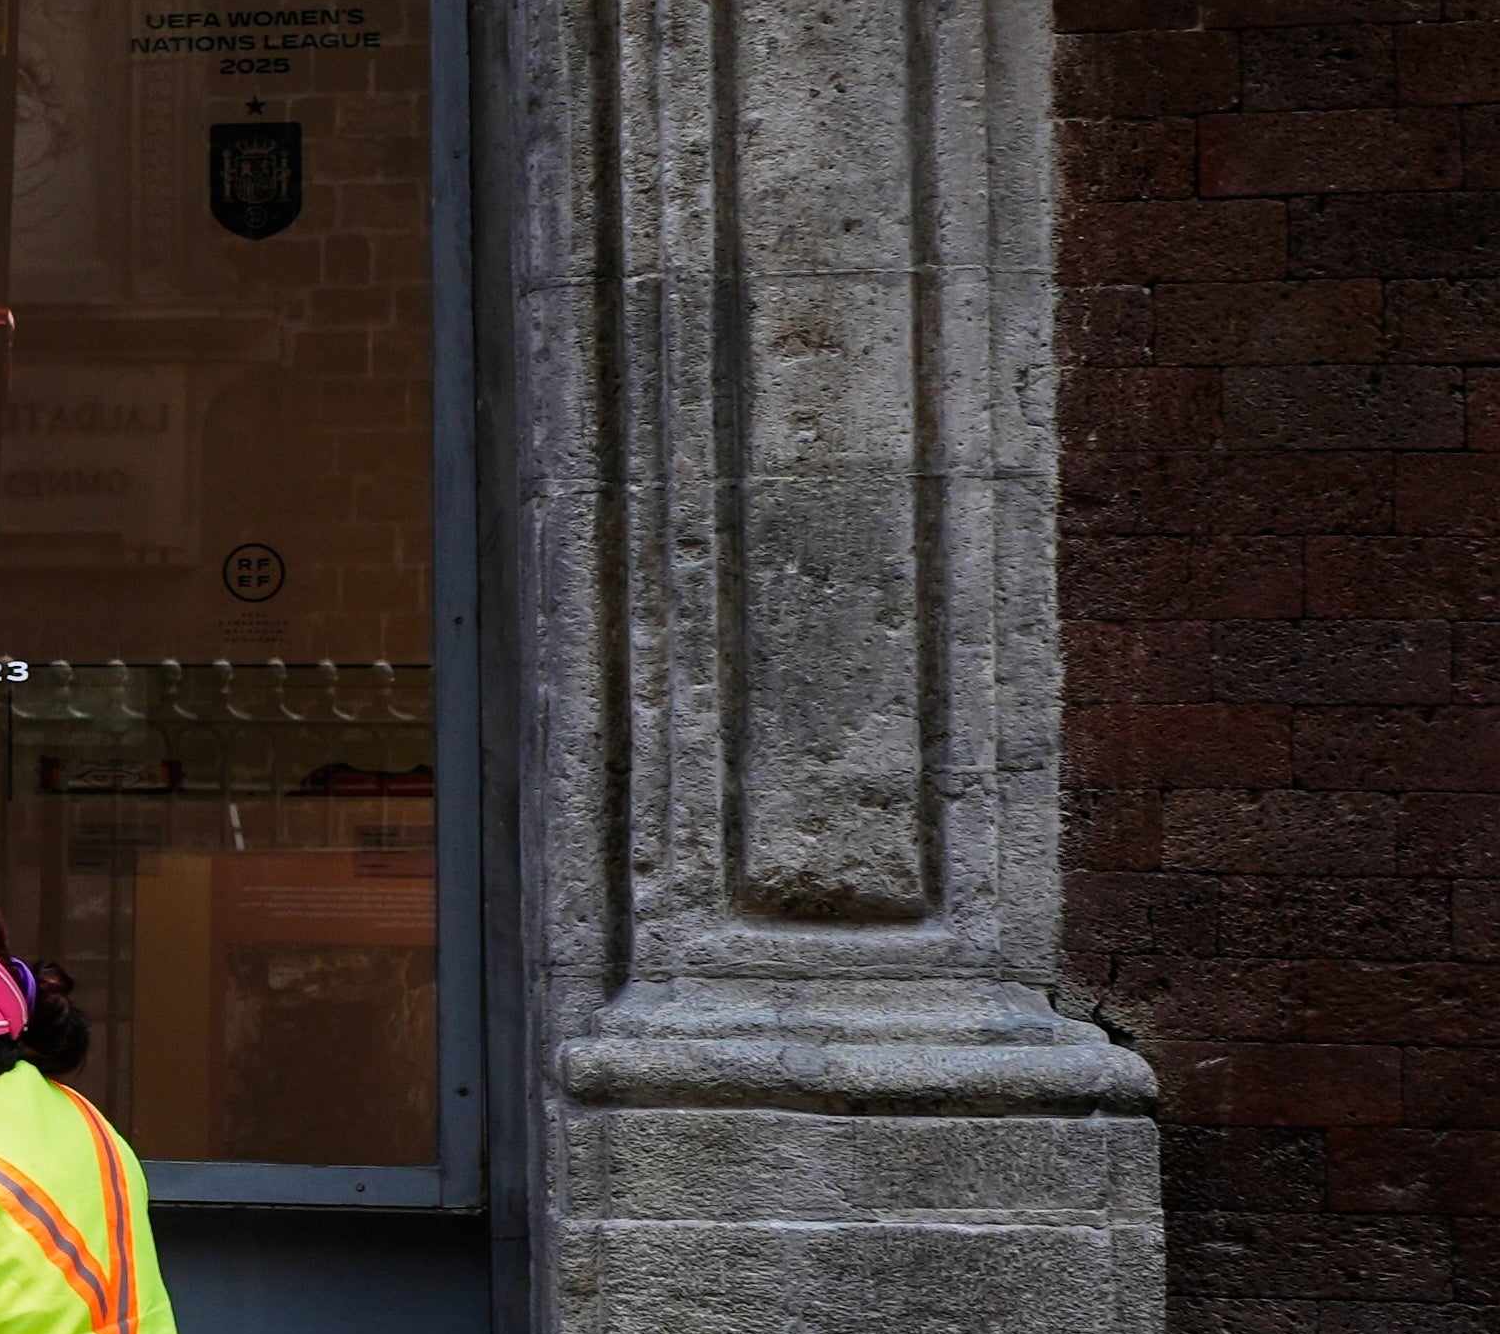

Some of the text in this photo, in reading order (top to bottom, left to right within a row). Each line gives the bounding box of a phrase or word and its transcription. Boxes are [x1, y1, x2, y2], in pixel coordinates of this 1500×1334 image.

[145, 8, 366, 30] UEFA WOMEN'S
[130, 32, 381, 53] NATIONS LEAGUE
[219, 58, 290, 75] 2025
